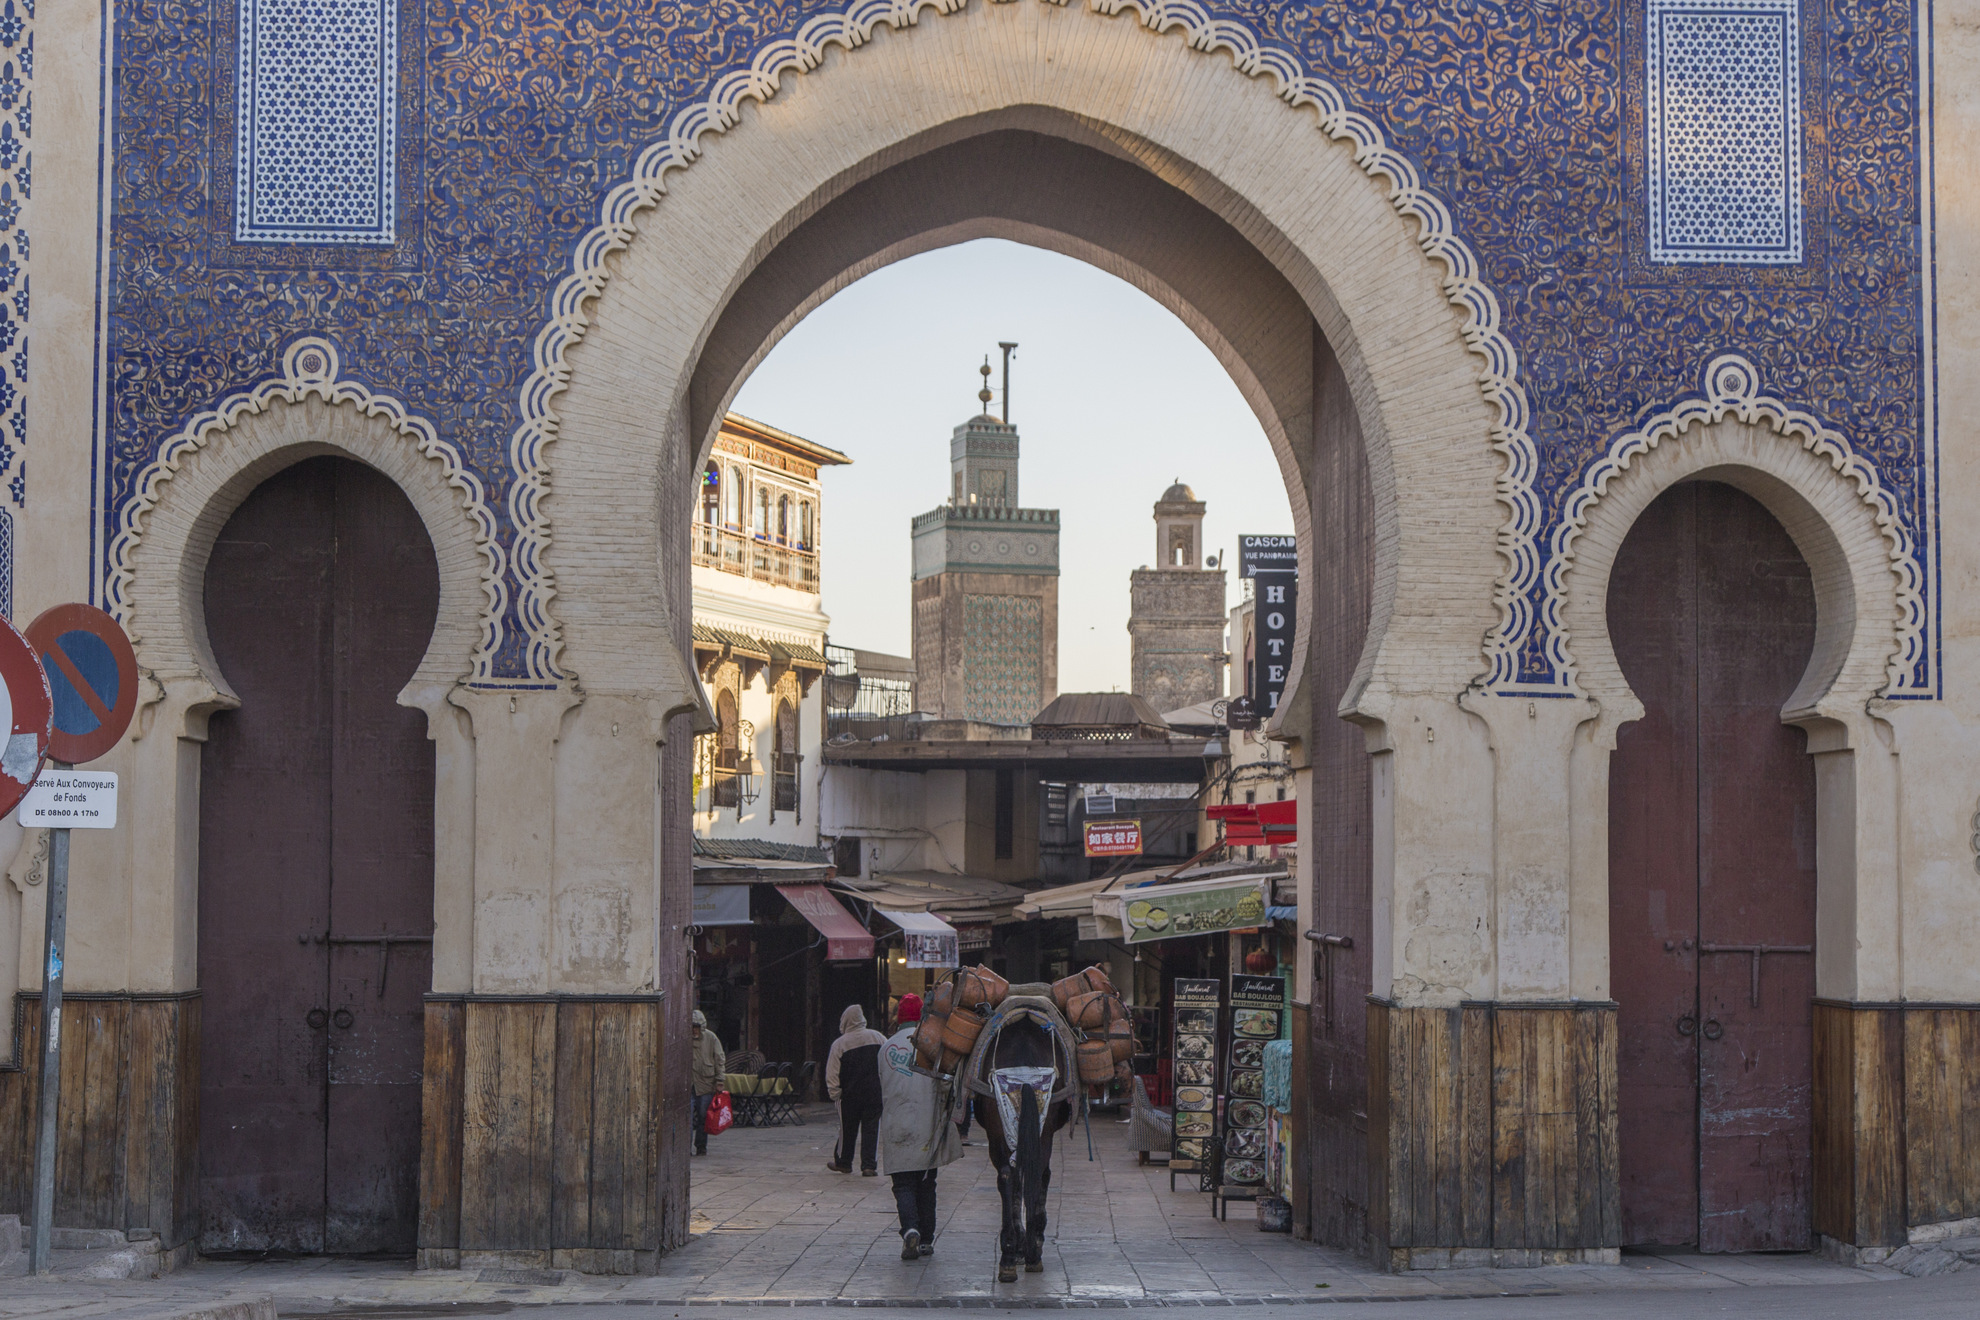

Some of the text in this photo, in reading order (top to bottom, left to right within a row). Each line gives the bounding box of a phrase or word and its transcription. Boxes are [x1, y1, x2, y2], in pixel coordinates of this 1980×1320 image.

[1245, 536, 1296, 547] CASCAD
[56, 778, 71, 788] Aux
[53, 792, 87, 802] de Fonds
